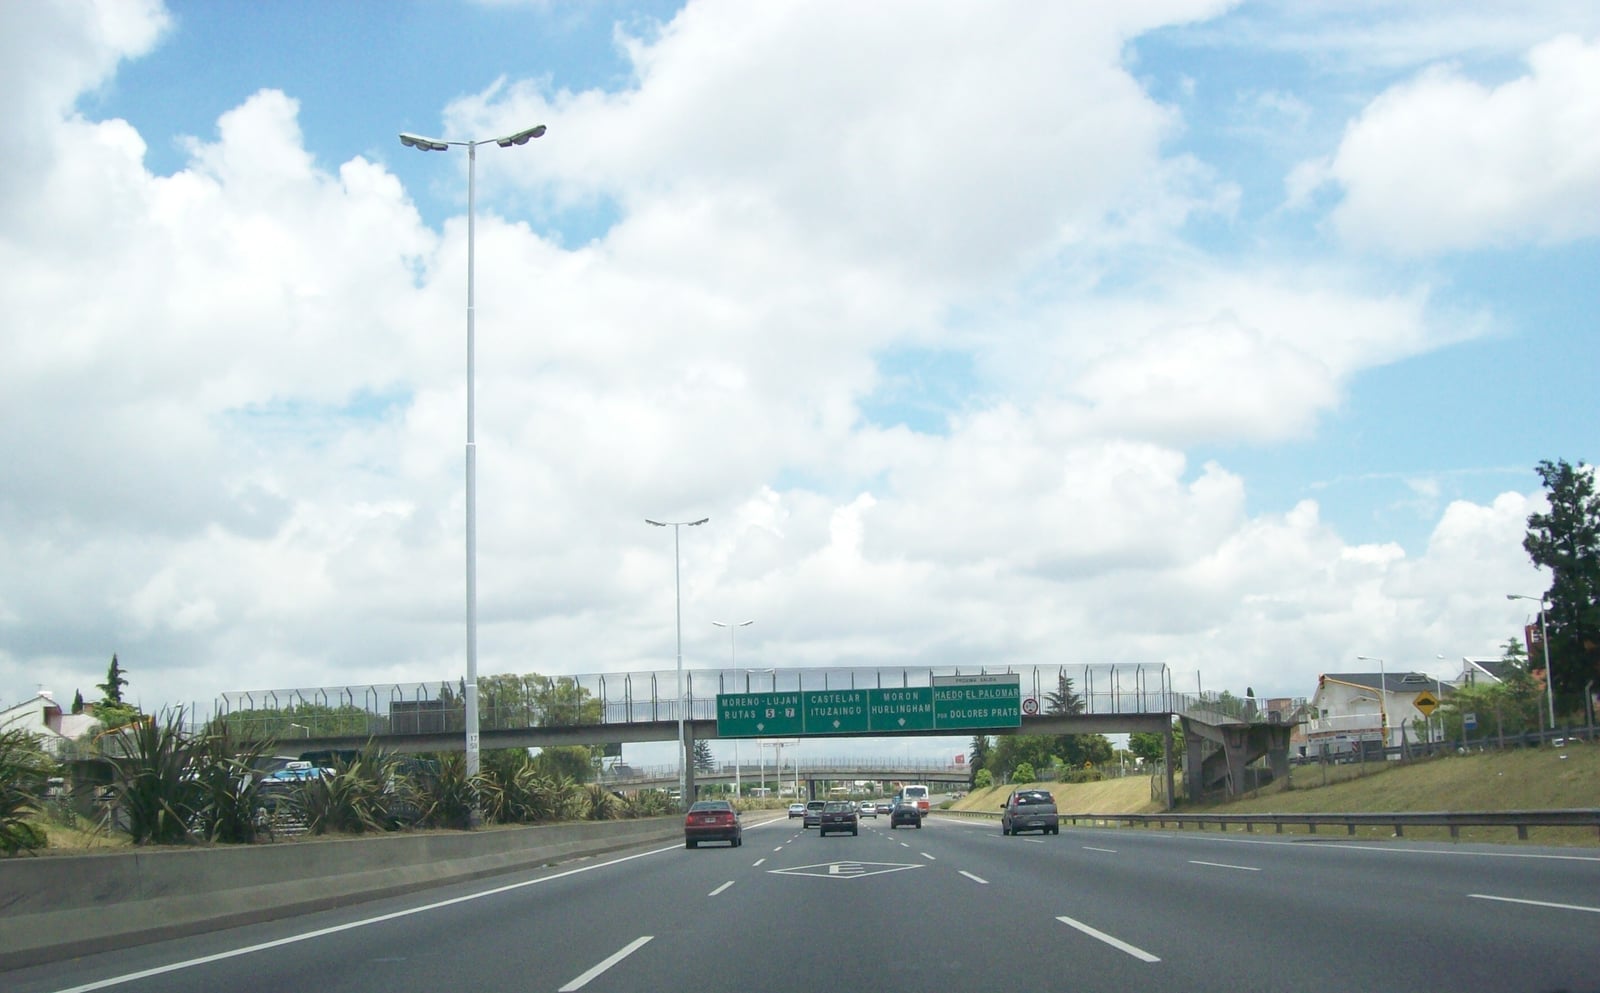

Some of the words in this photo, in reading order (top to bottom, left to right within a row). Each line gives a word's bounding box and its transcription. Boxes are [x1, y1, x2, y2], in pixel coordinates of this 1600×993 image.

[883, 691, 919, 701] MORON
[978, 688, 1019, 698] PALOMAR
[811, 694, 860, 704] CASTELAR
[810, 706, 862, 716] ITUZAINGO
[871, 704, 931, 714] HURLINGHAM
[950, 709, 988, 719] DOLORES
[991, 707, 1018, 717] PRATS
[724, 710, 756, 719] RUTAS
